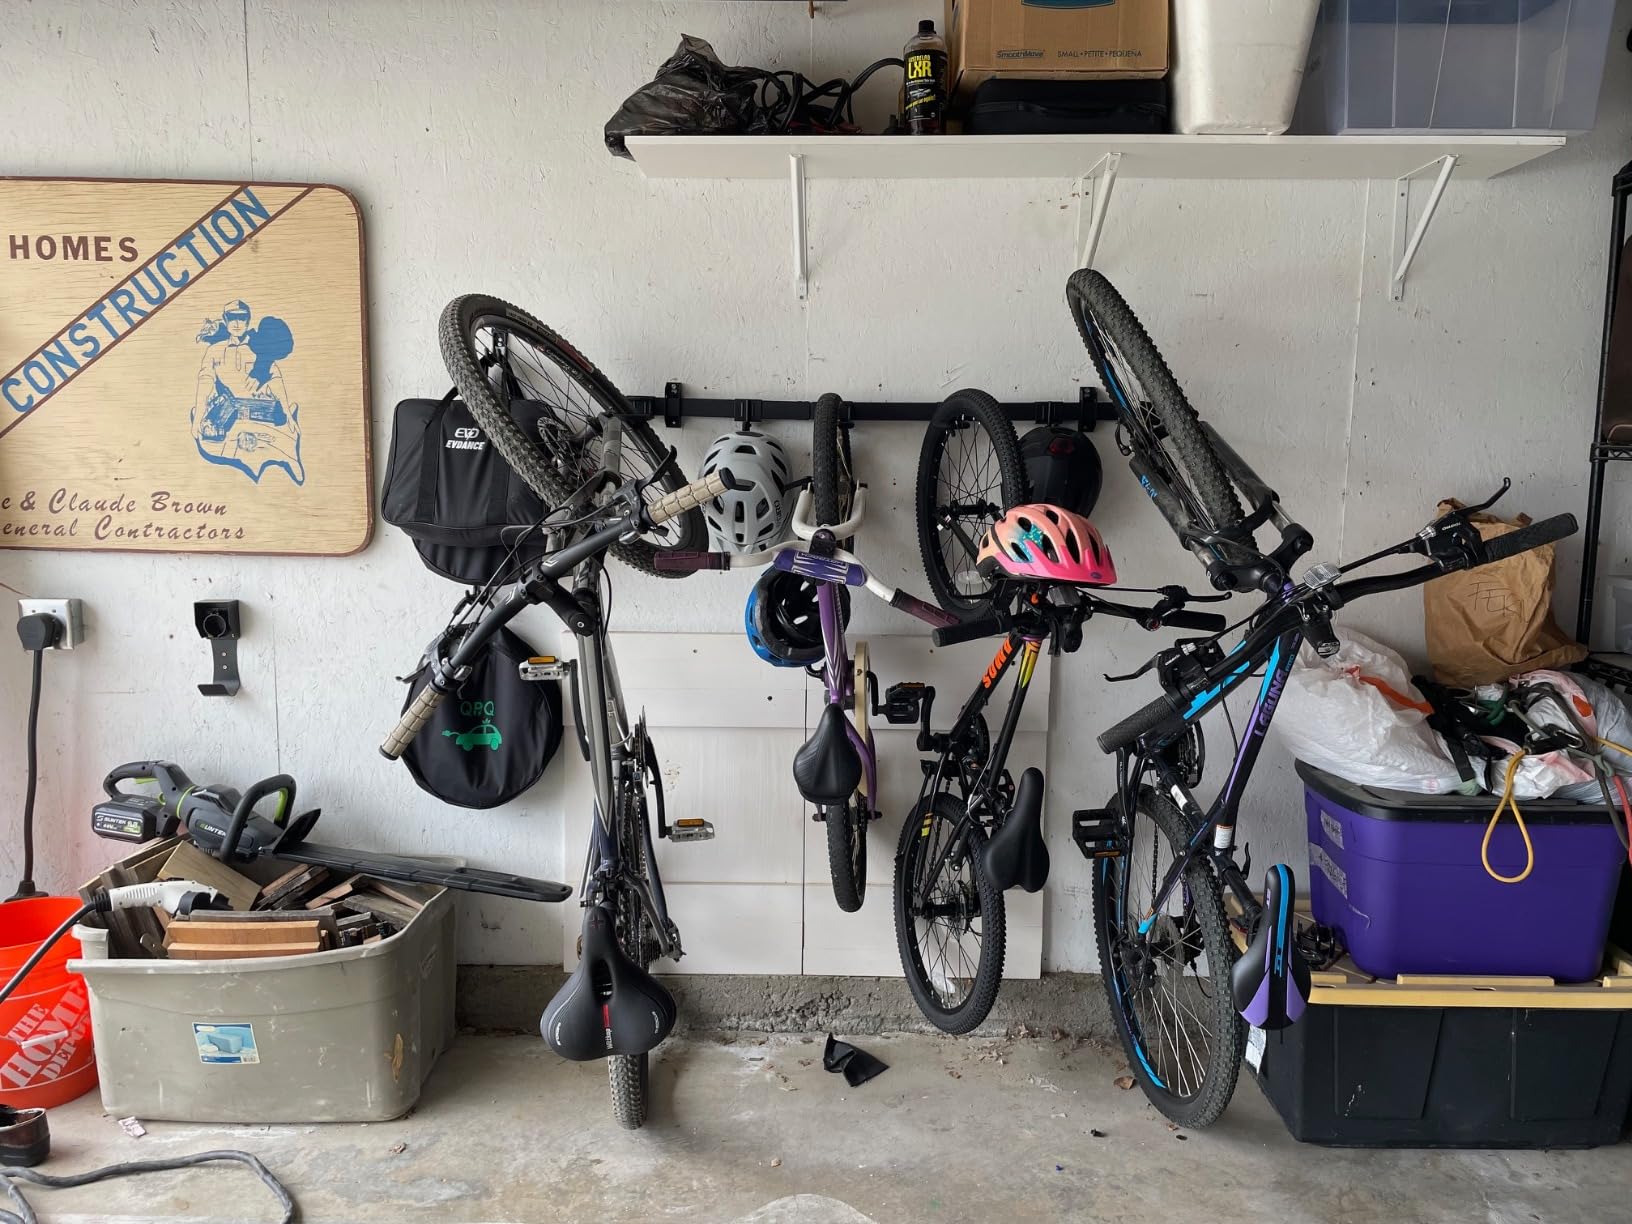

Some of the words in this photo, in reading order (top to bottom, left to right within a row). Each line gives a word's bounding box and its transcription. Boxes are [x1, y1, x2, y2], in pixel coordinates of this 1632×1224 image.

[1057, 50, 1079, 58] SMALL
[908, 60, 933, 80] LXR
[9, 234, 139, 262] HOMES
[1, 186, 272, 413] CONSTRUCTION
[445, 439, 486, 450] EVDANCE
[20, 490, 36, 511] &
[49, 487, 136, 514] Claude
[151, 491, 227, 515] Brown
[2, 518, 78, 537] eneral
[94, 514, 246, 541] Contractors
[1254, 667, 1286, 738] LAGUNA
[0, 979, 87, 1088] HOME
[7, 1003, 49, 1046] THE
